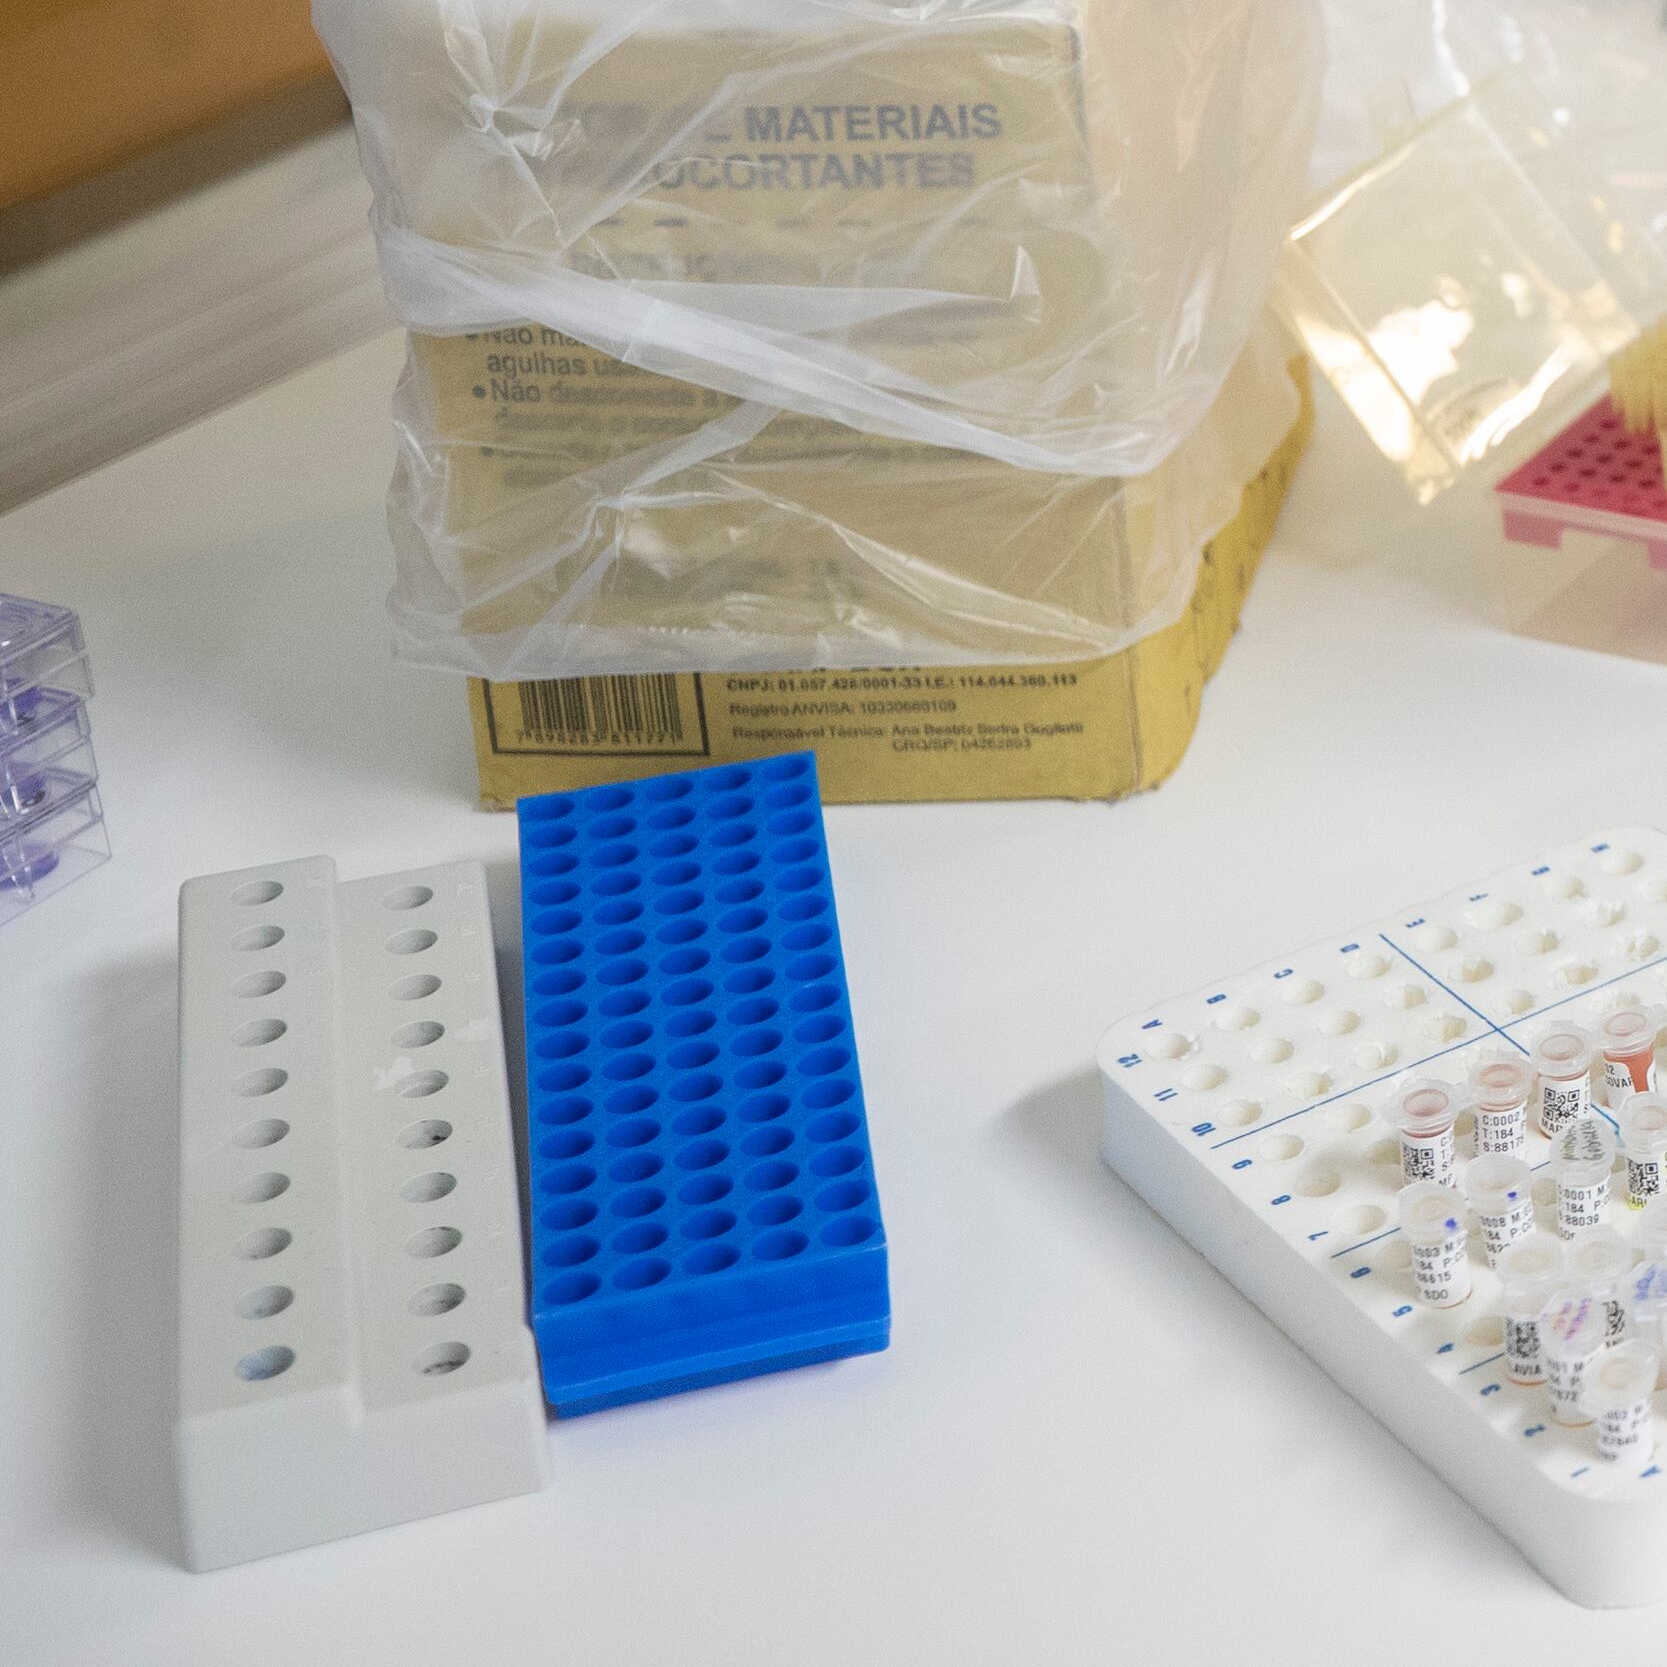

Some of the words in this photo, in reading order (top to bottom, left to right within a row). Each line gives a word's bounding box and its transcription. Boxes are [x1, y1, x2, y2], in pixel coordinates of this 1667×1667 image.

[744, 103, 1002, 142] MATERIAIS
[655, 151, 977, 191] OCORTANTES
[486, 351, 587, 377] agulhas
[489, 378, 542, 403] Não
[1339, 942, 1360, 954] D
[1273, 967, 1294, 979] C
[1205, 993, 1227, 1005] B
[1141, 1018, 1163, 1030] A
[1482, 1112, 1521, 1126] C:0002
[1483, 1128, 1515, 1140] T:184
